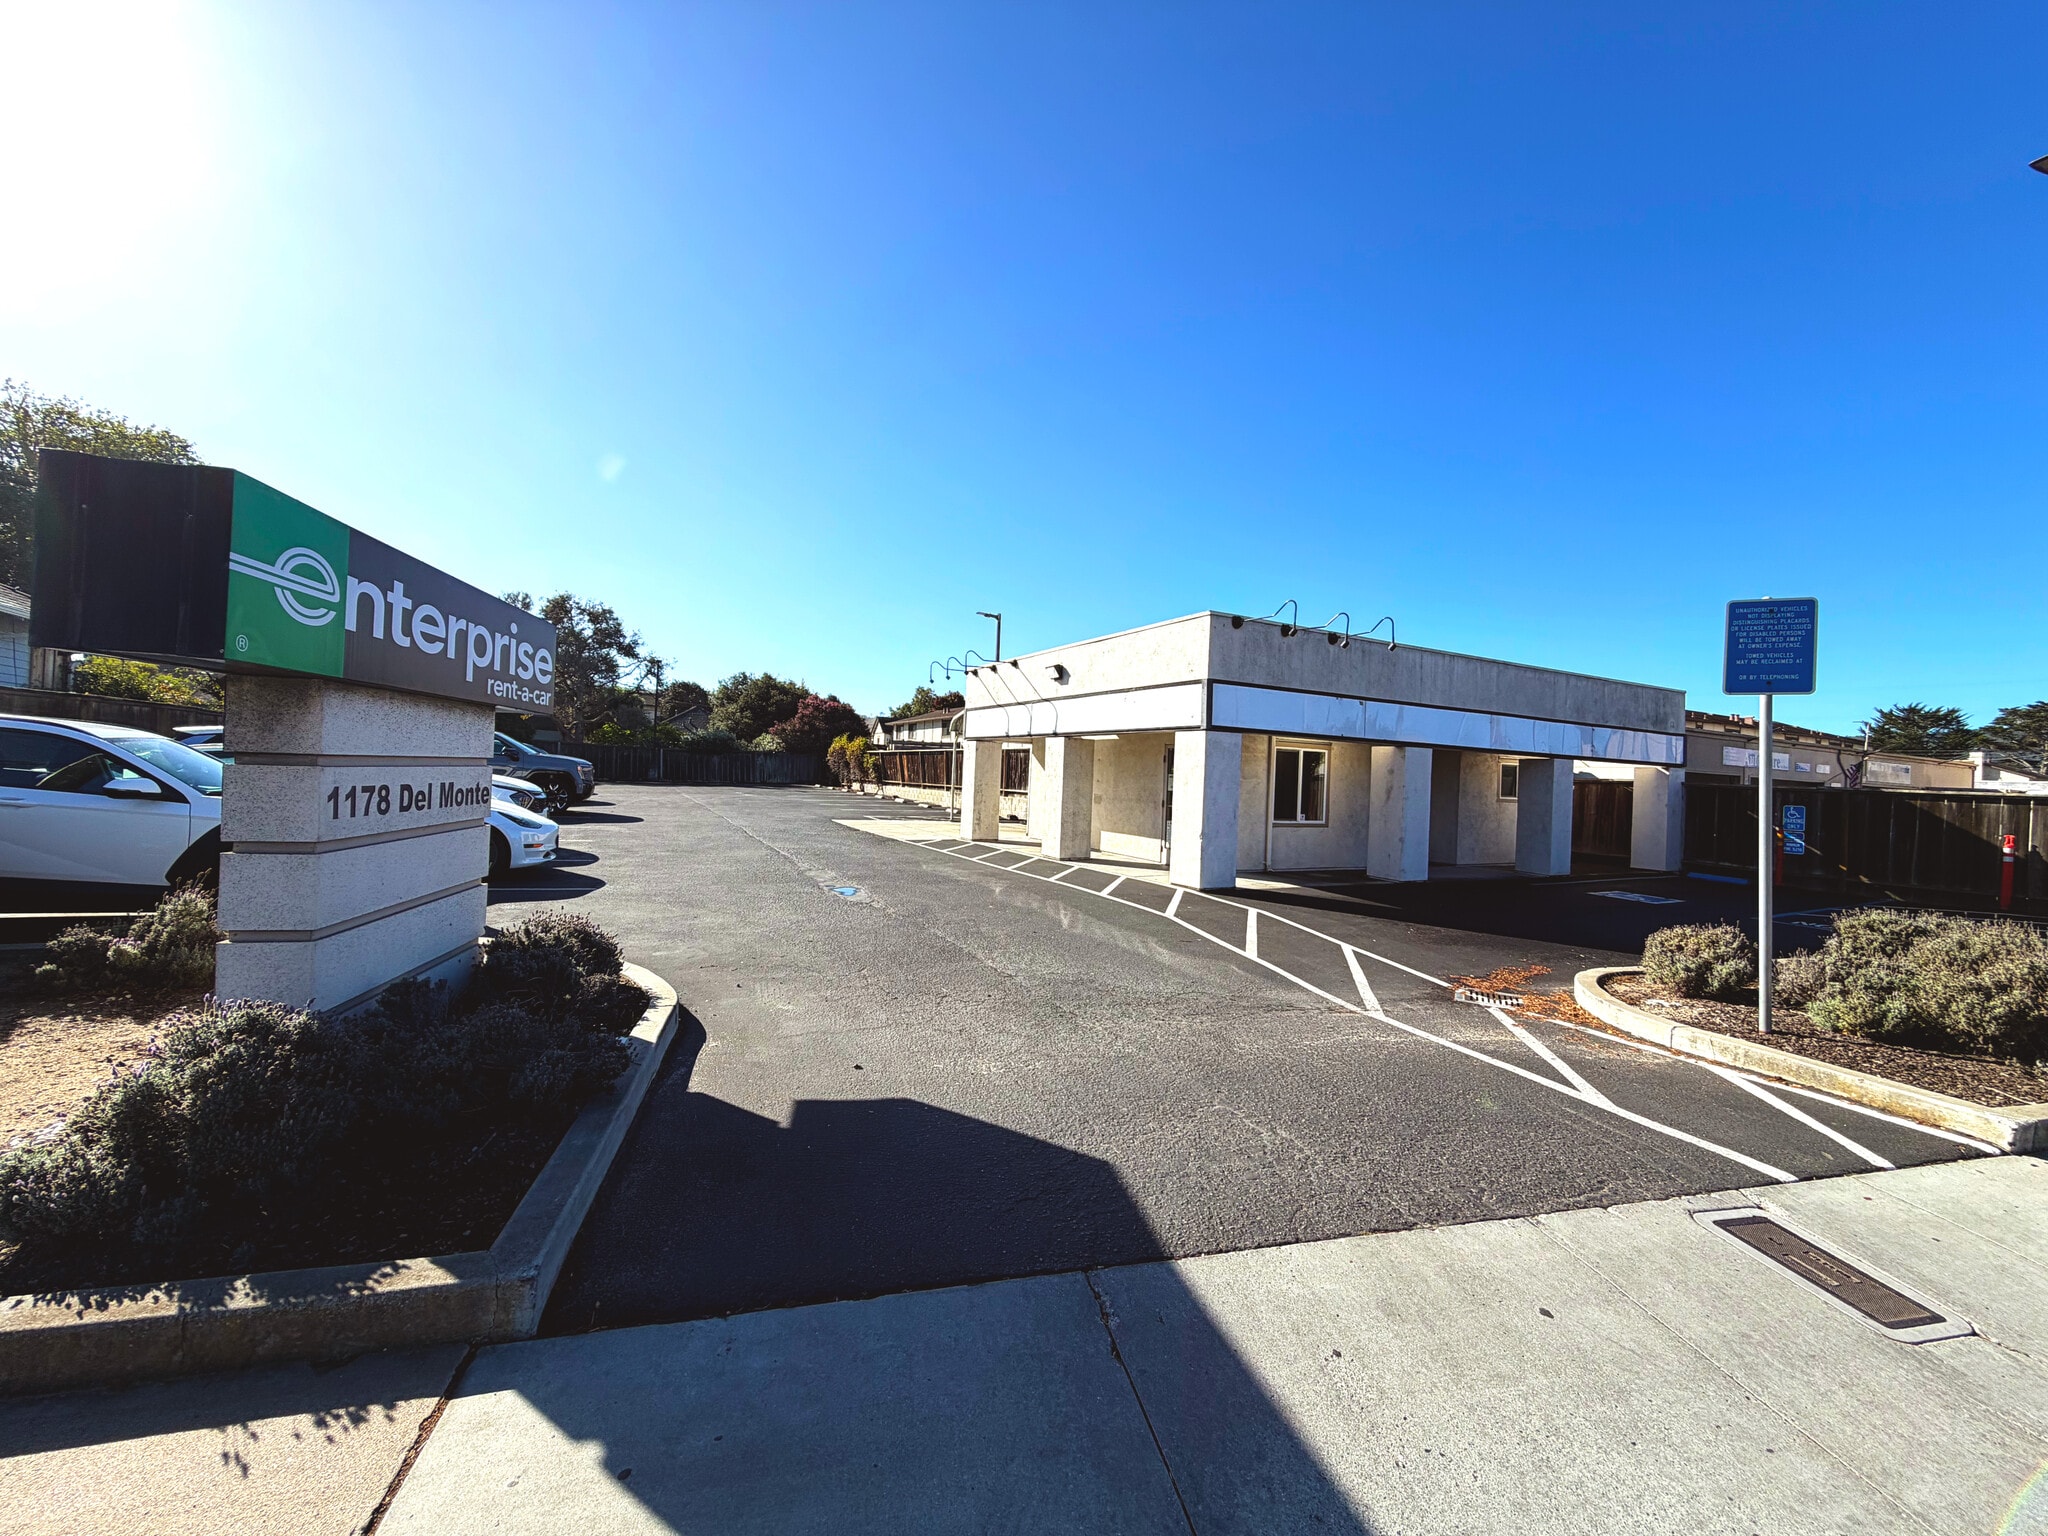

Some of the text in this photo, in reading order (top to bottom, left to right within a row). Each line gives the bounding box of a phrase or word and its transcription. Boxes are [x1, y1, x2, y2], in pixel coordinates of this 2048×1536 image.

[229, 546, 554, 685] enterprise
[486, 676, 552, 706] rent-a-car
[326, 781, 491, 820] 1178 Del Monte
